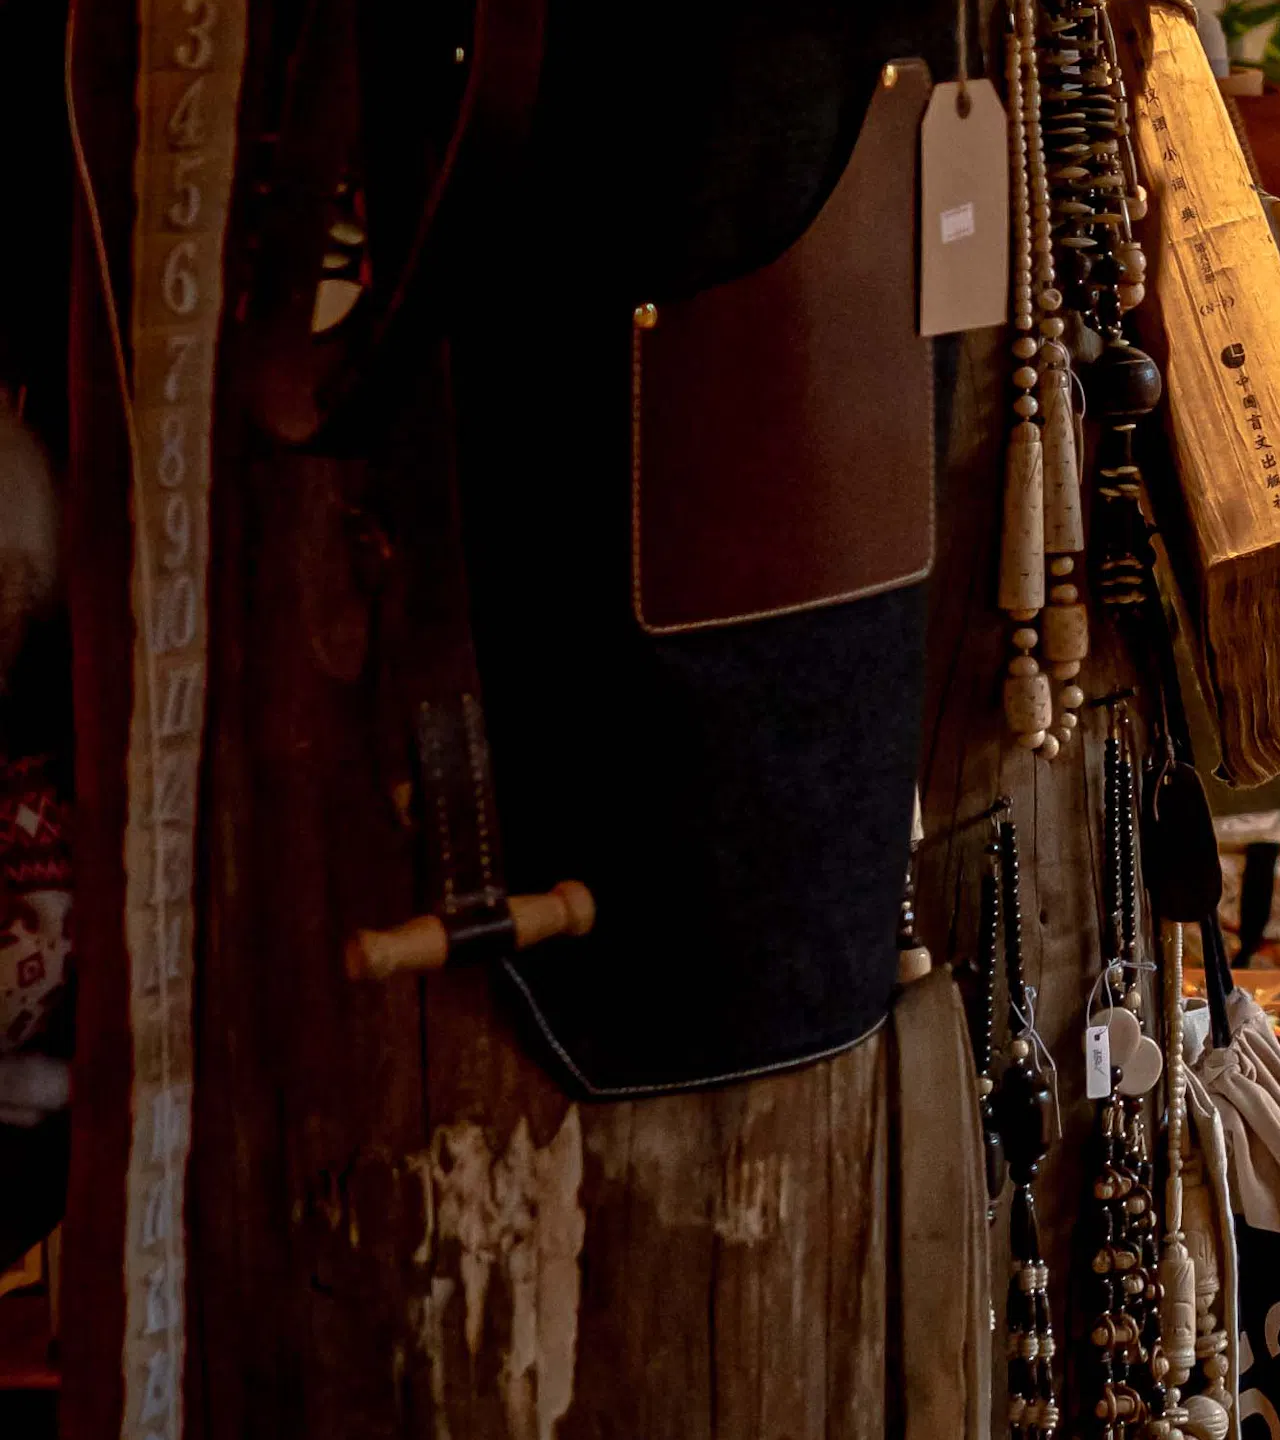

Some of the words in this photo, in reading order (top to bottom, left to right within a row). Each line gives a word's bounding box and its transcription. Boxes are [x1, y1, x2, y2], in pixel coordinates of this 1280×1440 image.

[167, 77, 205, 148] 4
[168, 150, 204, 226] 5
[1142, 86, 1198, 224] 汉语小词典
[163, 240, 198, 314] 6
[163, 333, 196, 402] 7
[157, 414, 186, 487] 8
[163, 492, 193, 568] 9
